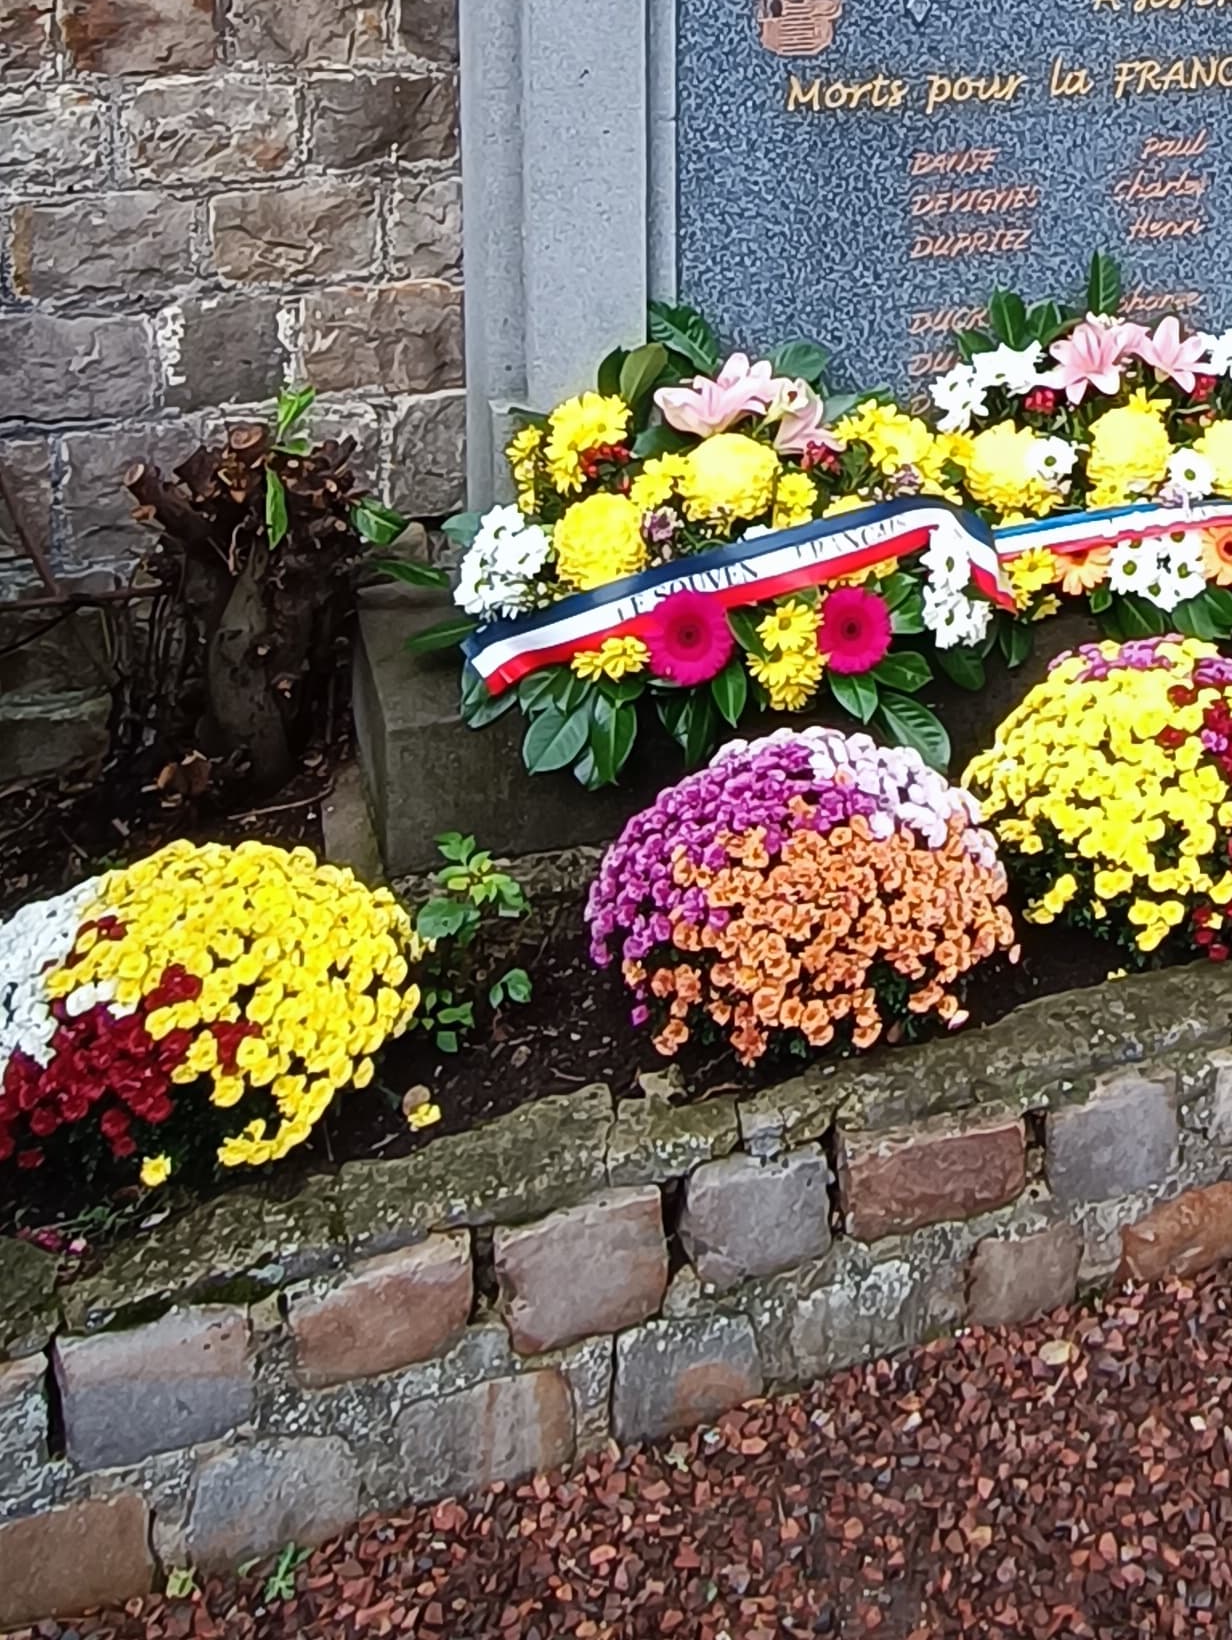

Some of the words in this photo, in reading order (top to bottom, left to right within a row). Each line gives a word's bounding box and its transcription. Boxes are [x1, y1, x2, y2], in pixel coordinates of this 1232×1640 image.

[787, 74, 910, 112] Morts
[926, 71, 1028, 115] pour
[1050, 57, 1095, 97] la
[1127, 215, 1207, 242] Henri
